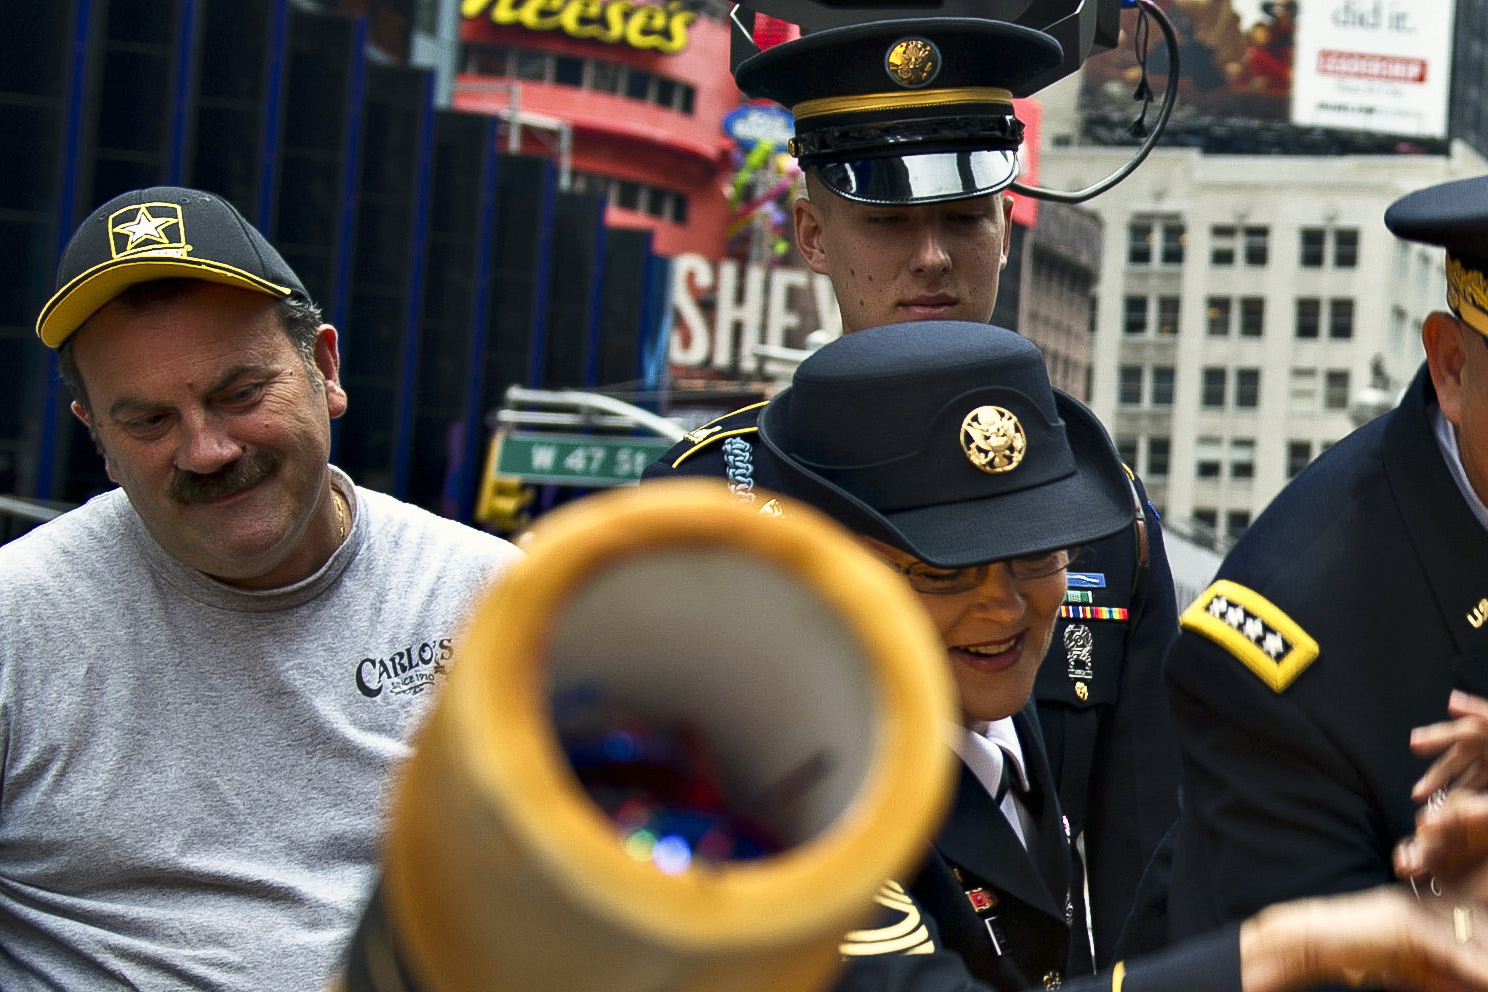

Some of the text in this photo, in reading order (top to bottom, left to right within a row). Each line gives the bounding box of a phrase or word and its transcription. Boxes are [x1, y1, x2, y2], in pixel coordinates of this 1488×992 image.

[531, 444, 647, 476] W 47 St
[355, 638, 454, 698] CARLO'S
